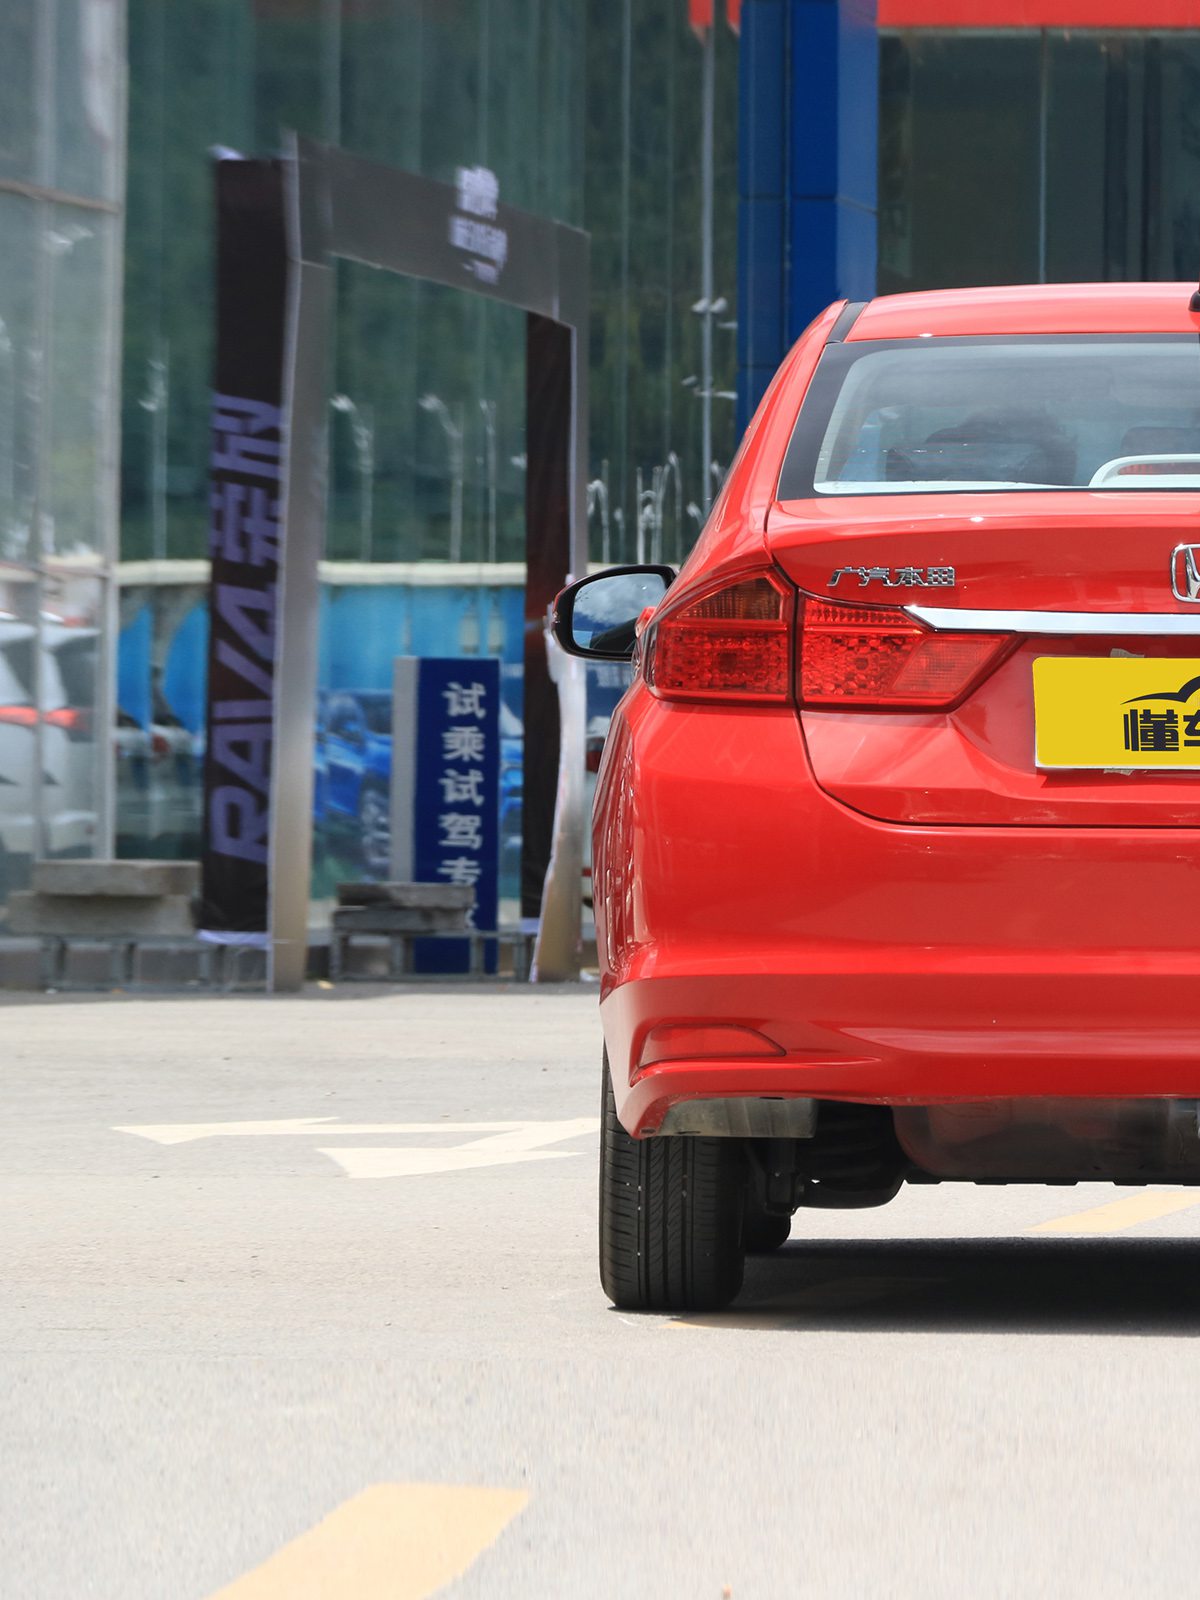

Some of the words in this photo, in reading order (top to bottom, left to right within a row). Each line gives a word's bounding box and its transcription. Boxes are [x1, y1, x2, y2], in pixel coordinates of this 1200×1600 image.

[826, 566, 955, 587] 广汽本田
[436, 682, 488, 930] 试乘试驾专
